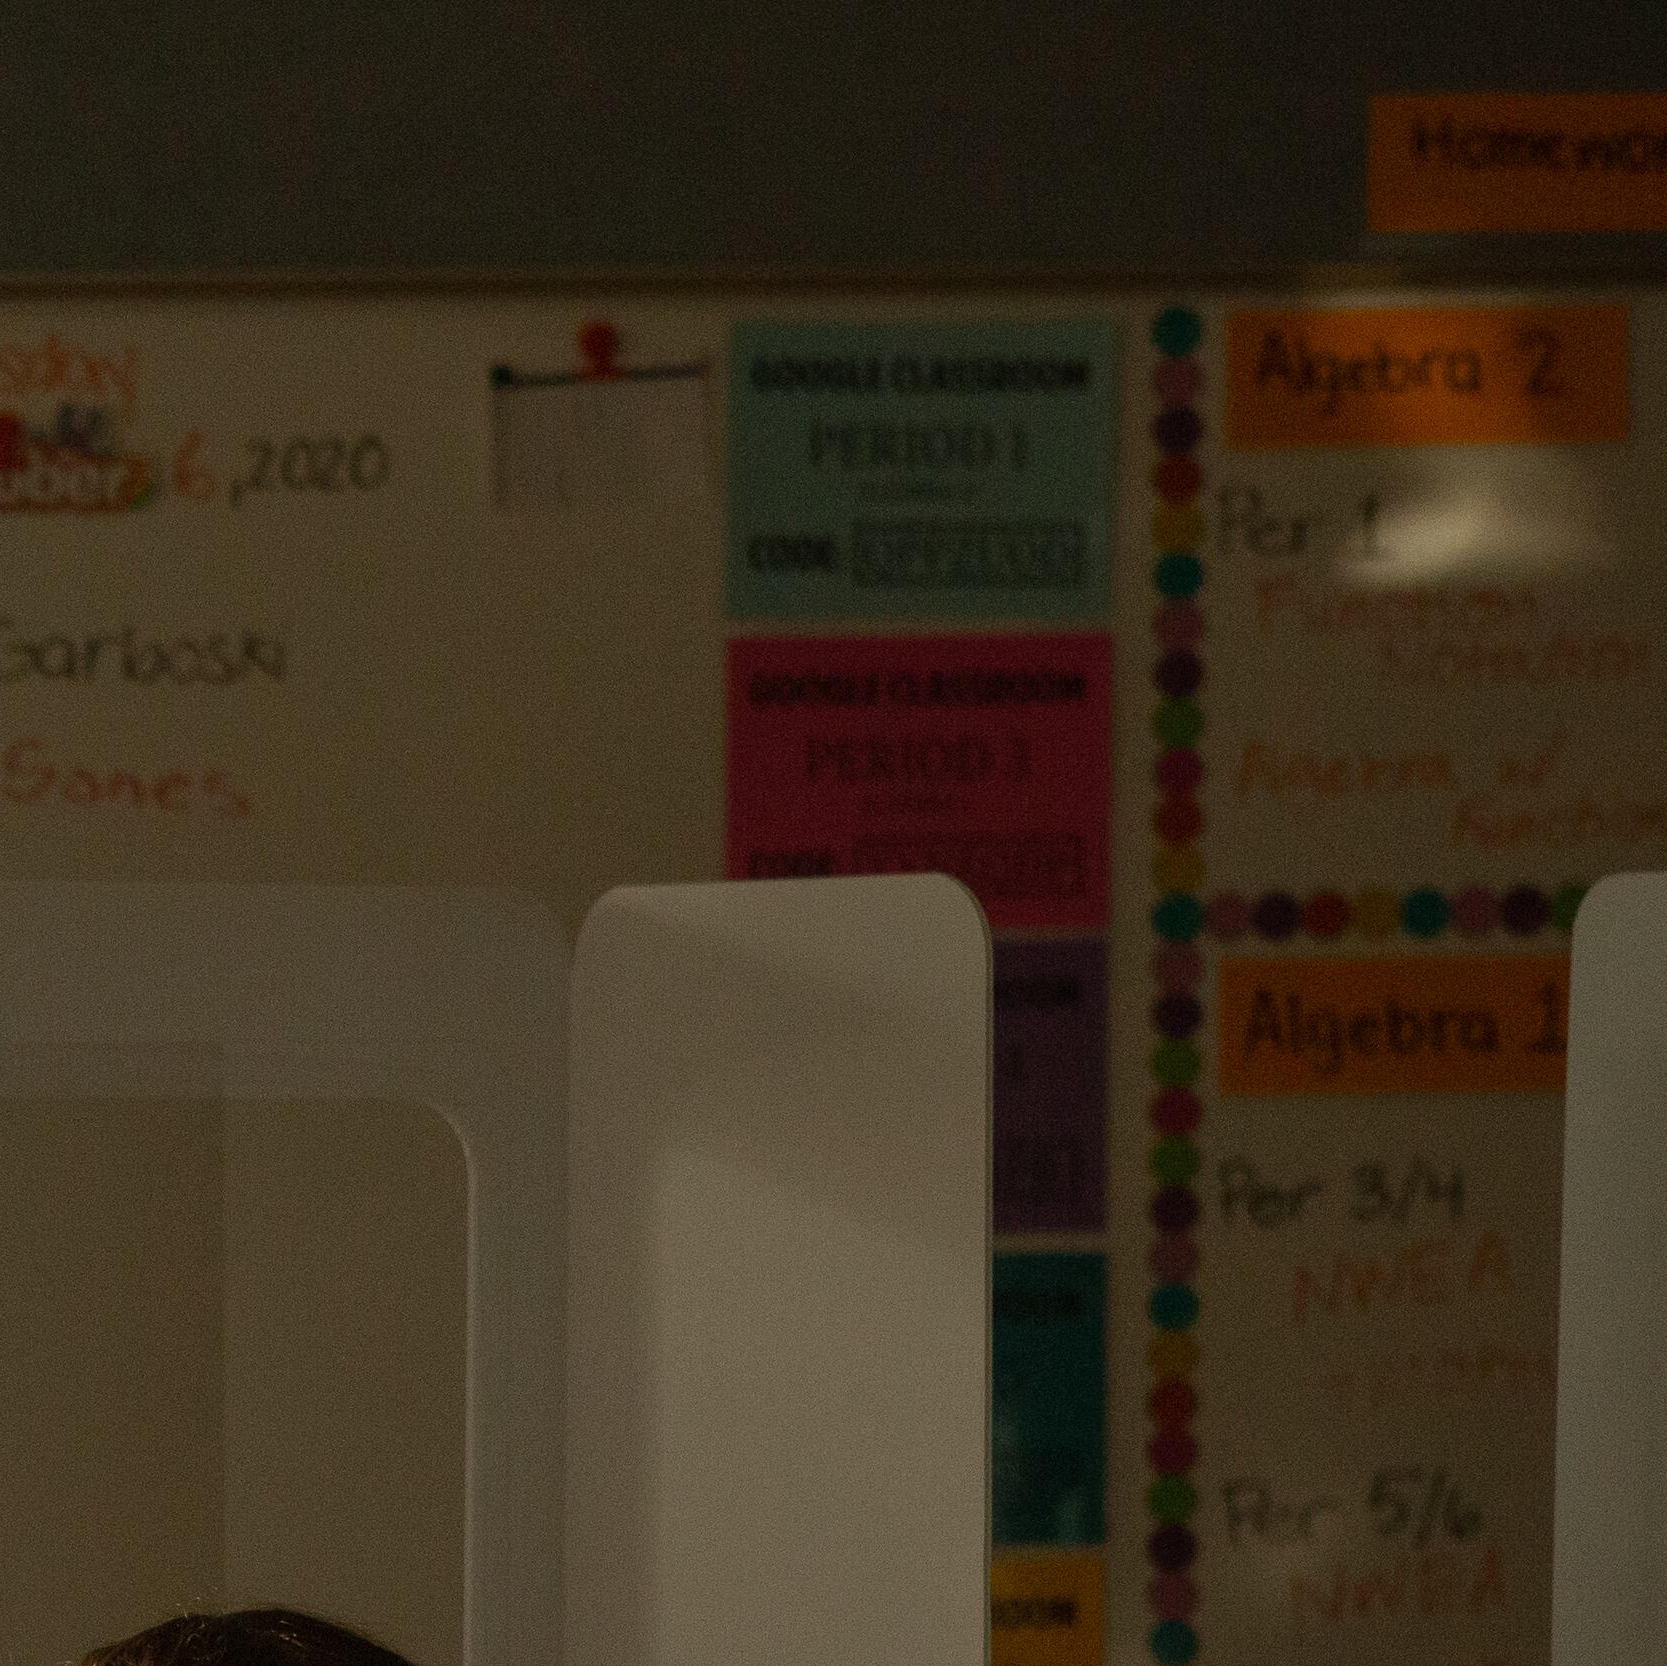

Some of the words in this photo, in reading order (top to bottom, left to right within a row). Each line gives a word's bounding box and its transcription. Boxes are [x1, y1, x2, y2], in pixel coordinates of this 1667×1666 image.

[1410, 113, 1667, 173] Homewo
[1257, 330, 1481, 417] Algebra
[1517, 327, 1563, 399] 2
[809, 421, 997, 470] PERIOD
[1243, 986, 1501, 1078] Algebra
[1521, 974, 1567, 1056] 1
[1218, 1154, 1323, 1231] Per
